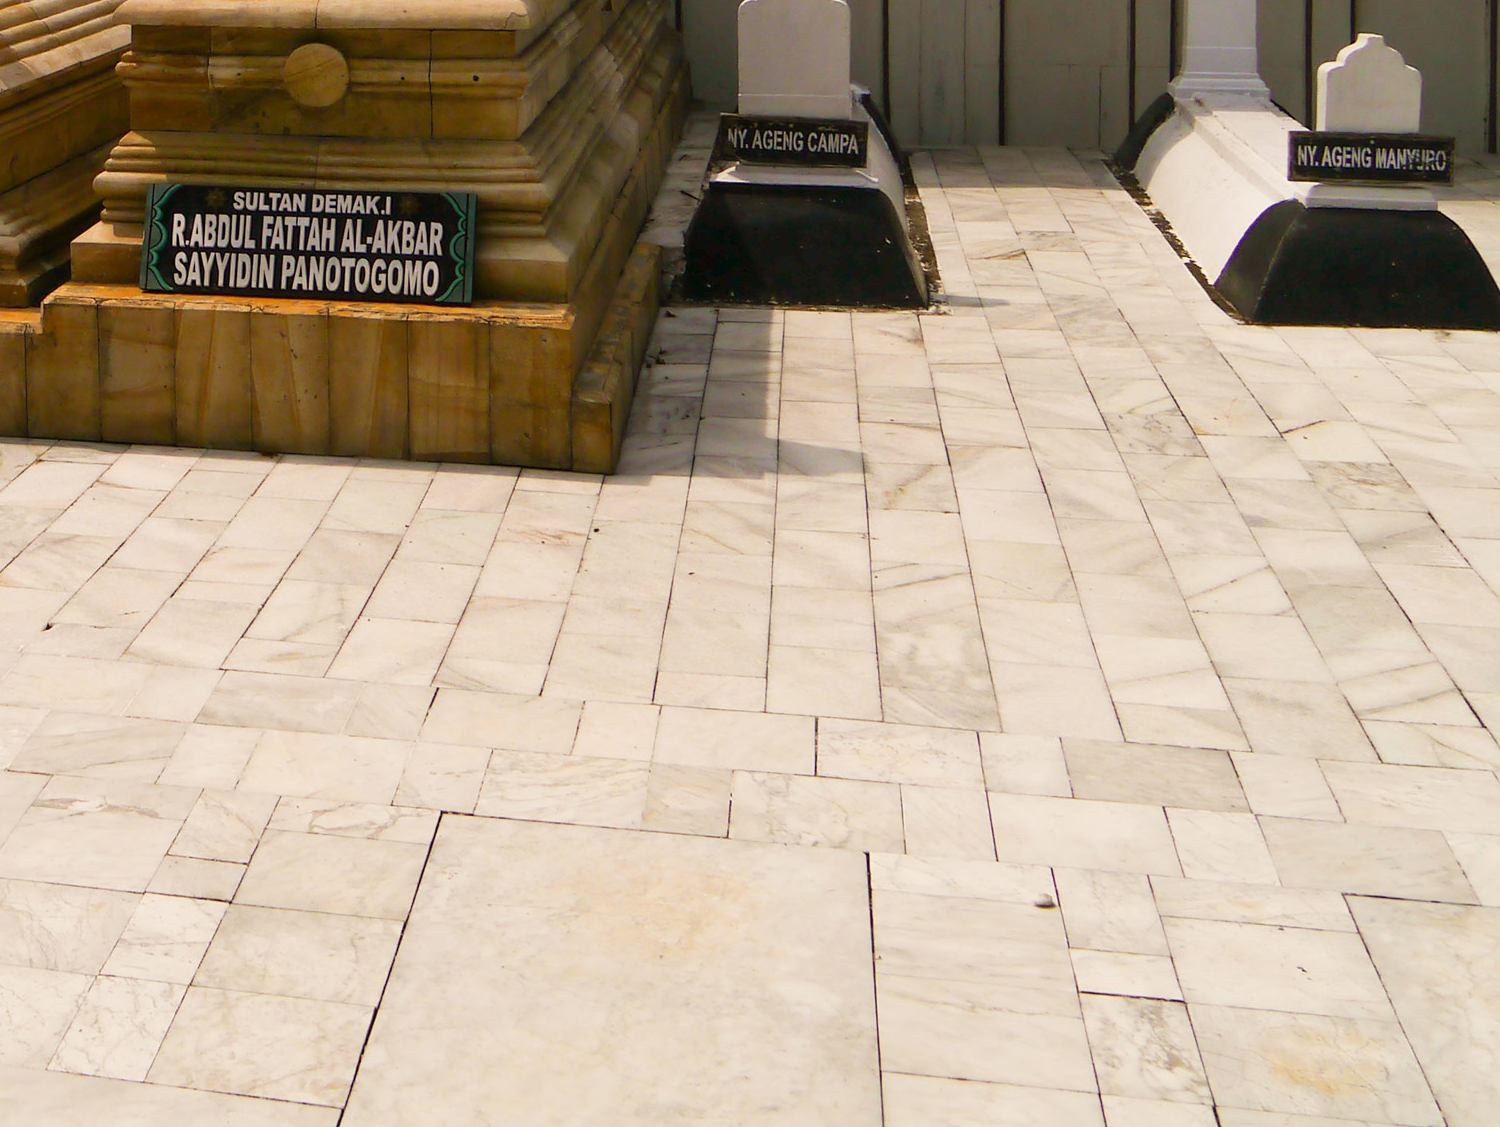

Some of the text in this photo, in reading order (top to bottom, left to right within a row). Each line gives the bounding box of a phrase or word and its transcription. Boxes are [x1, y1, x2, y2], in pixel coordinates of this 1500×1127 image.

[727, 128, 859, 155] NY. AGENG CAMPA
[1297, 145, 1447, 171] NY. AGENG MANYURO
[232, 191, 392, 216] SULTAN DEMAK.I
[171, 213, 444, 257] R.ABDUL FATTAH AL-AKBAR
[173, 251, 441, 297] SAYYIDIN PANOTOGOMO
